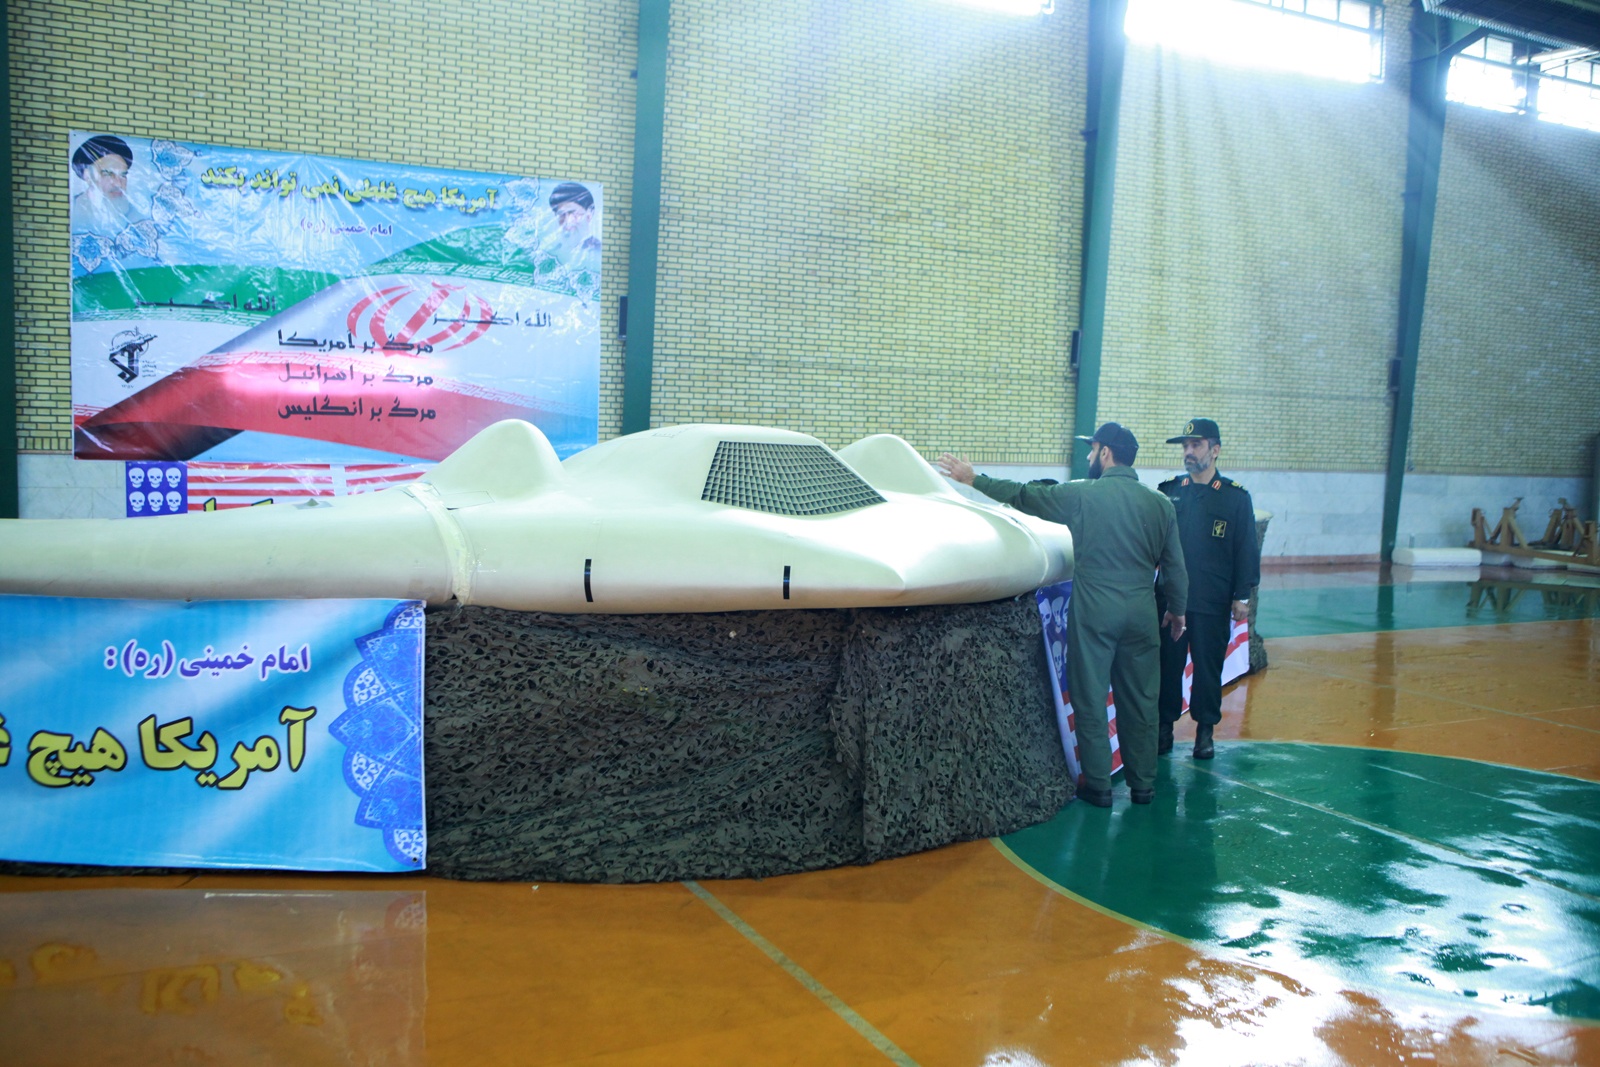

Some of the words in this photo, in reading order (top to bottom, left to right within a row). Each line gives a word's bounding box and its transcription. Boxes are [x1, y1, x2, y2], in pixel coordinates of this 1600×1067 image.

[201, 165, 245, 193] بکند
[301, 175, 340, 199] نمی
[344, 177, 397, 203] غلطی
[403, 187, 437, 208] هیچ
[441, 186, 498, 214] آمریکا
[301, 217, 326, 234] (ره)
[330, 222, 366, 236] خمینی
[370, 223, 392, 236] امام
[362, 340, 376, 354] بر
[382, 333, 434, 355] مرگ
[362, 374, 375, 386] بر
[382, 364, 434, 387] مرگ
[278, 395, 363, 421] انگلیس
[369, 406, 382, 422] بر
[388, 396, 437, 423] مرگ
[179, 645, 255, 678] خمینی
[261, 644, 310, 680] امام
[27, 727, 128, 788] هیچ
[139, 705, 317, 790] آمریکا
